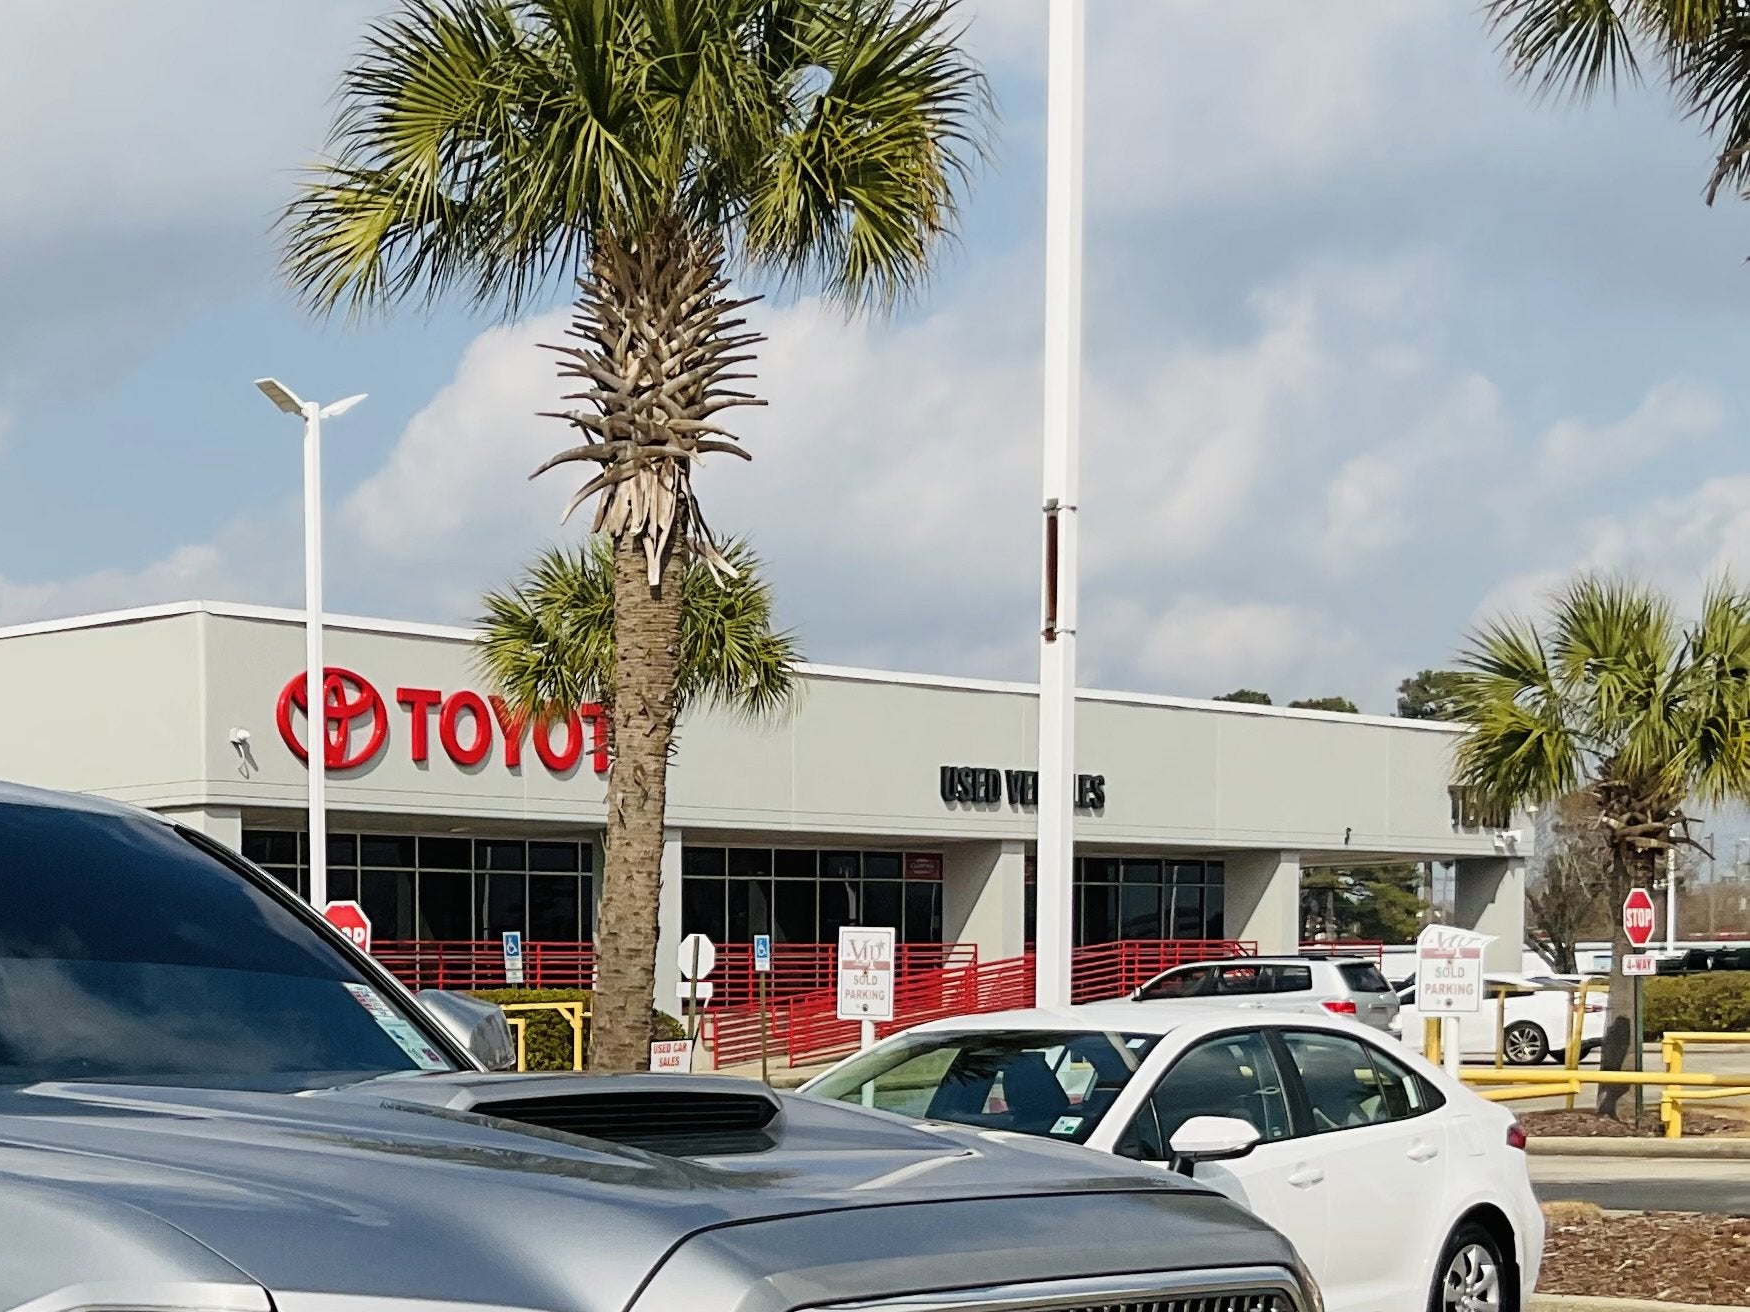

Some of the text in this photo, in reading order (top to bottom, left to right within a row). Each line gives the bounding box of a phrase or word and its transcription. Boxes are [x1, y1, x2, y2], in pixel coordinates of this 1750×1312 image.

[396, 687, 609, 774] TOYOT
[940, 766, 1106, 809] USED VELES
[1626, 907, 1652, 928] STOP
[1626, 959, 1652, 971] 4-WAY
[1435, 966, 1465, 978] SOLD
[853, 975, 878, 986] SOLD
[845, 988, 885, 1001] PARKING
[1424, 983, 1474, 995] PARKING
[653, 1042, 687, 1054] USED CAR
[659, 1056, 680, 1067] SALES
